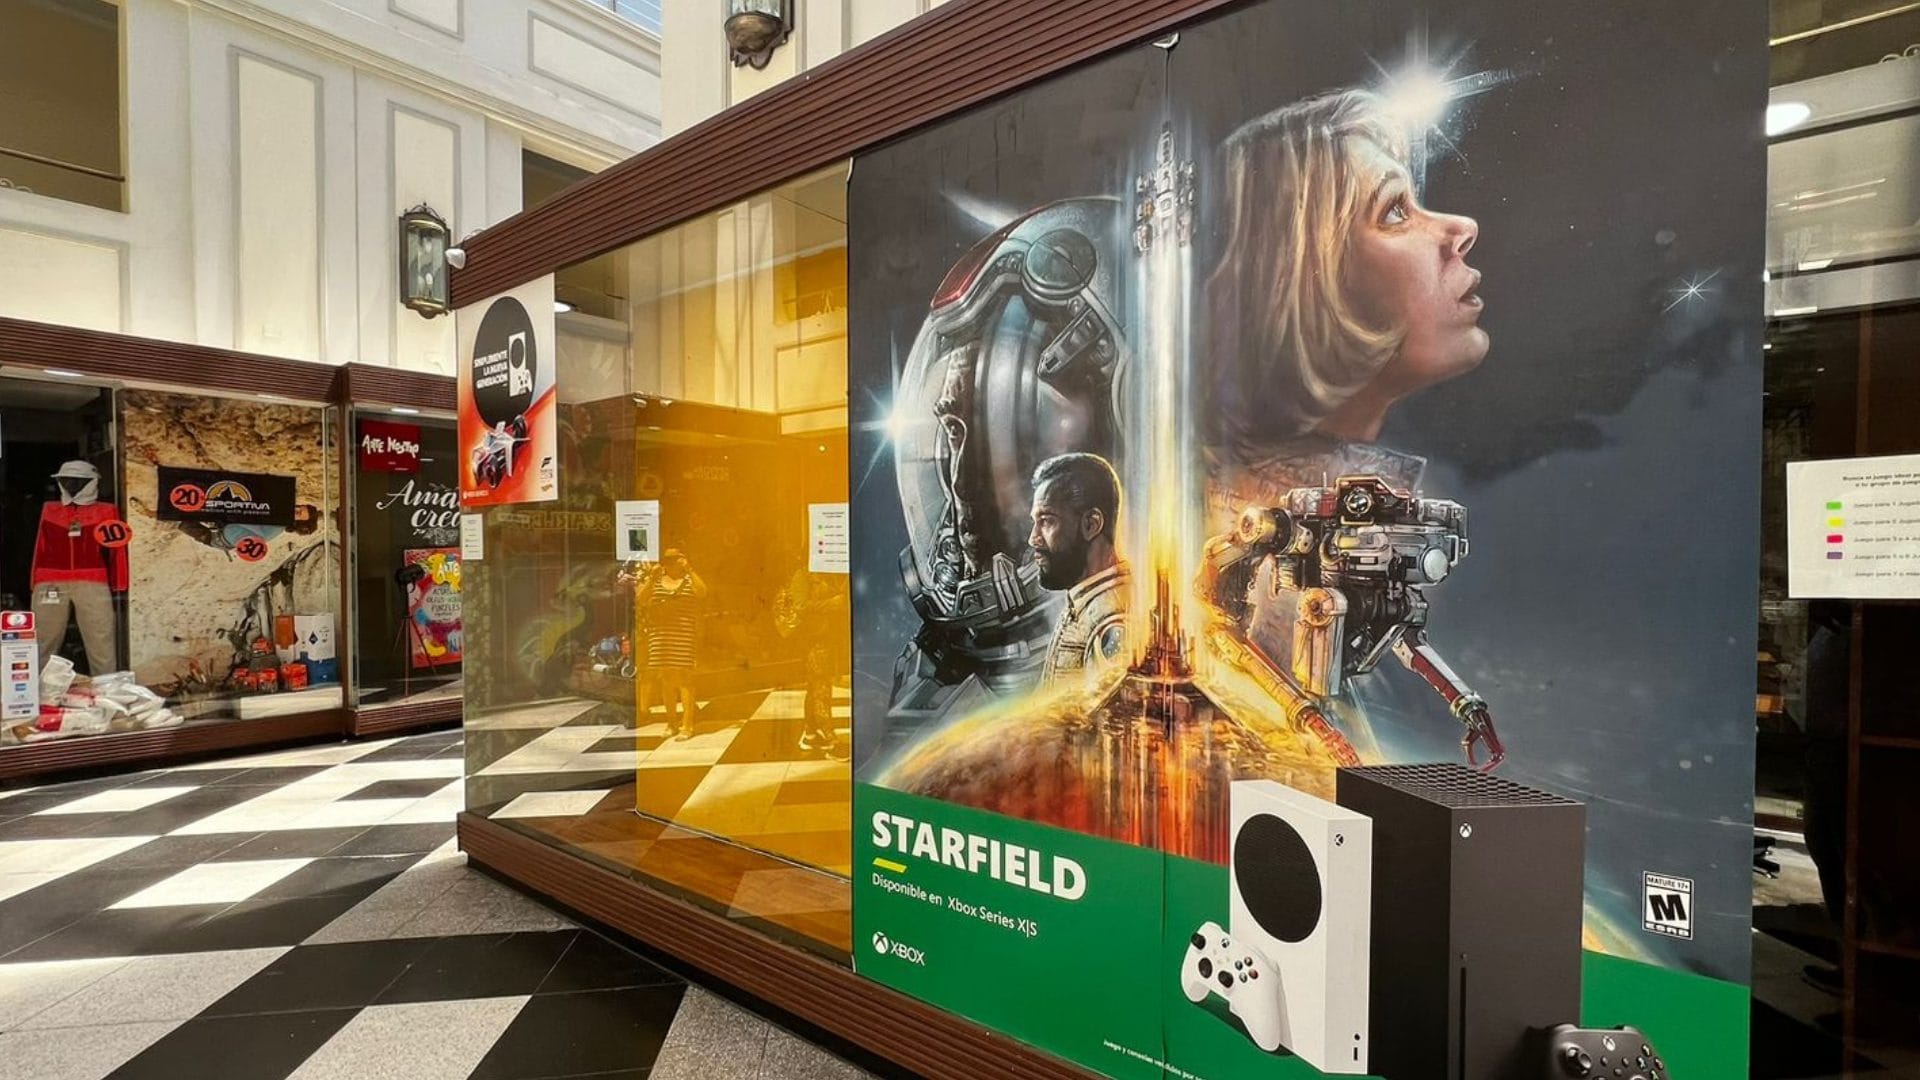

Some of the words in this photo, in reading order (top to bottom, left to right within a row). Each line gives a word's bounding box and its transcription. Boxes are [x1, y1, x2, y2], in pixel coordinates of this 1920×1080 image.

[174, 489, 199, 506] 20
[205, 500, 270, 510] SPORTIVA
[376, 479, 460, 510] Ama
[98, 523, 126, 544] 10
[237, 538, 264, 558] 30
[872, 811, 1087, 901] STARFIELD
[1648, 877, 1676, 888] MATURE
[872, 872, 927, 902] Disponible
[928, 893, 943, 906] en
[947, 896, 978, 917] Xbox
[979, 906, 1015, 930] Series
[1649, 894, 1687, 921] M
[890, 939, 926, 967] XBOX
